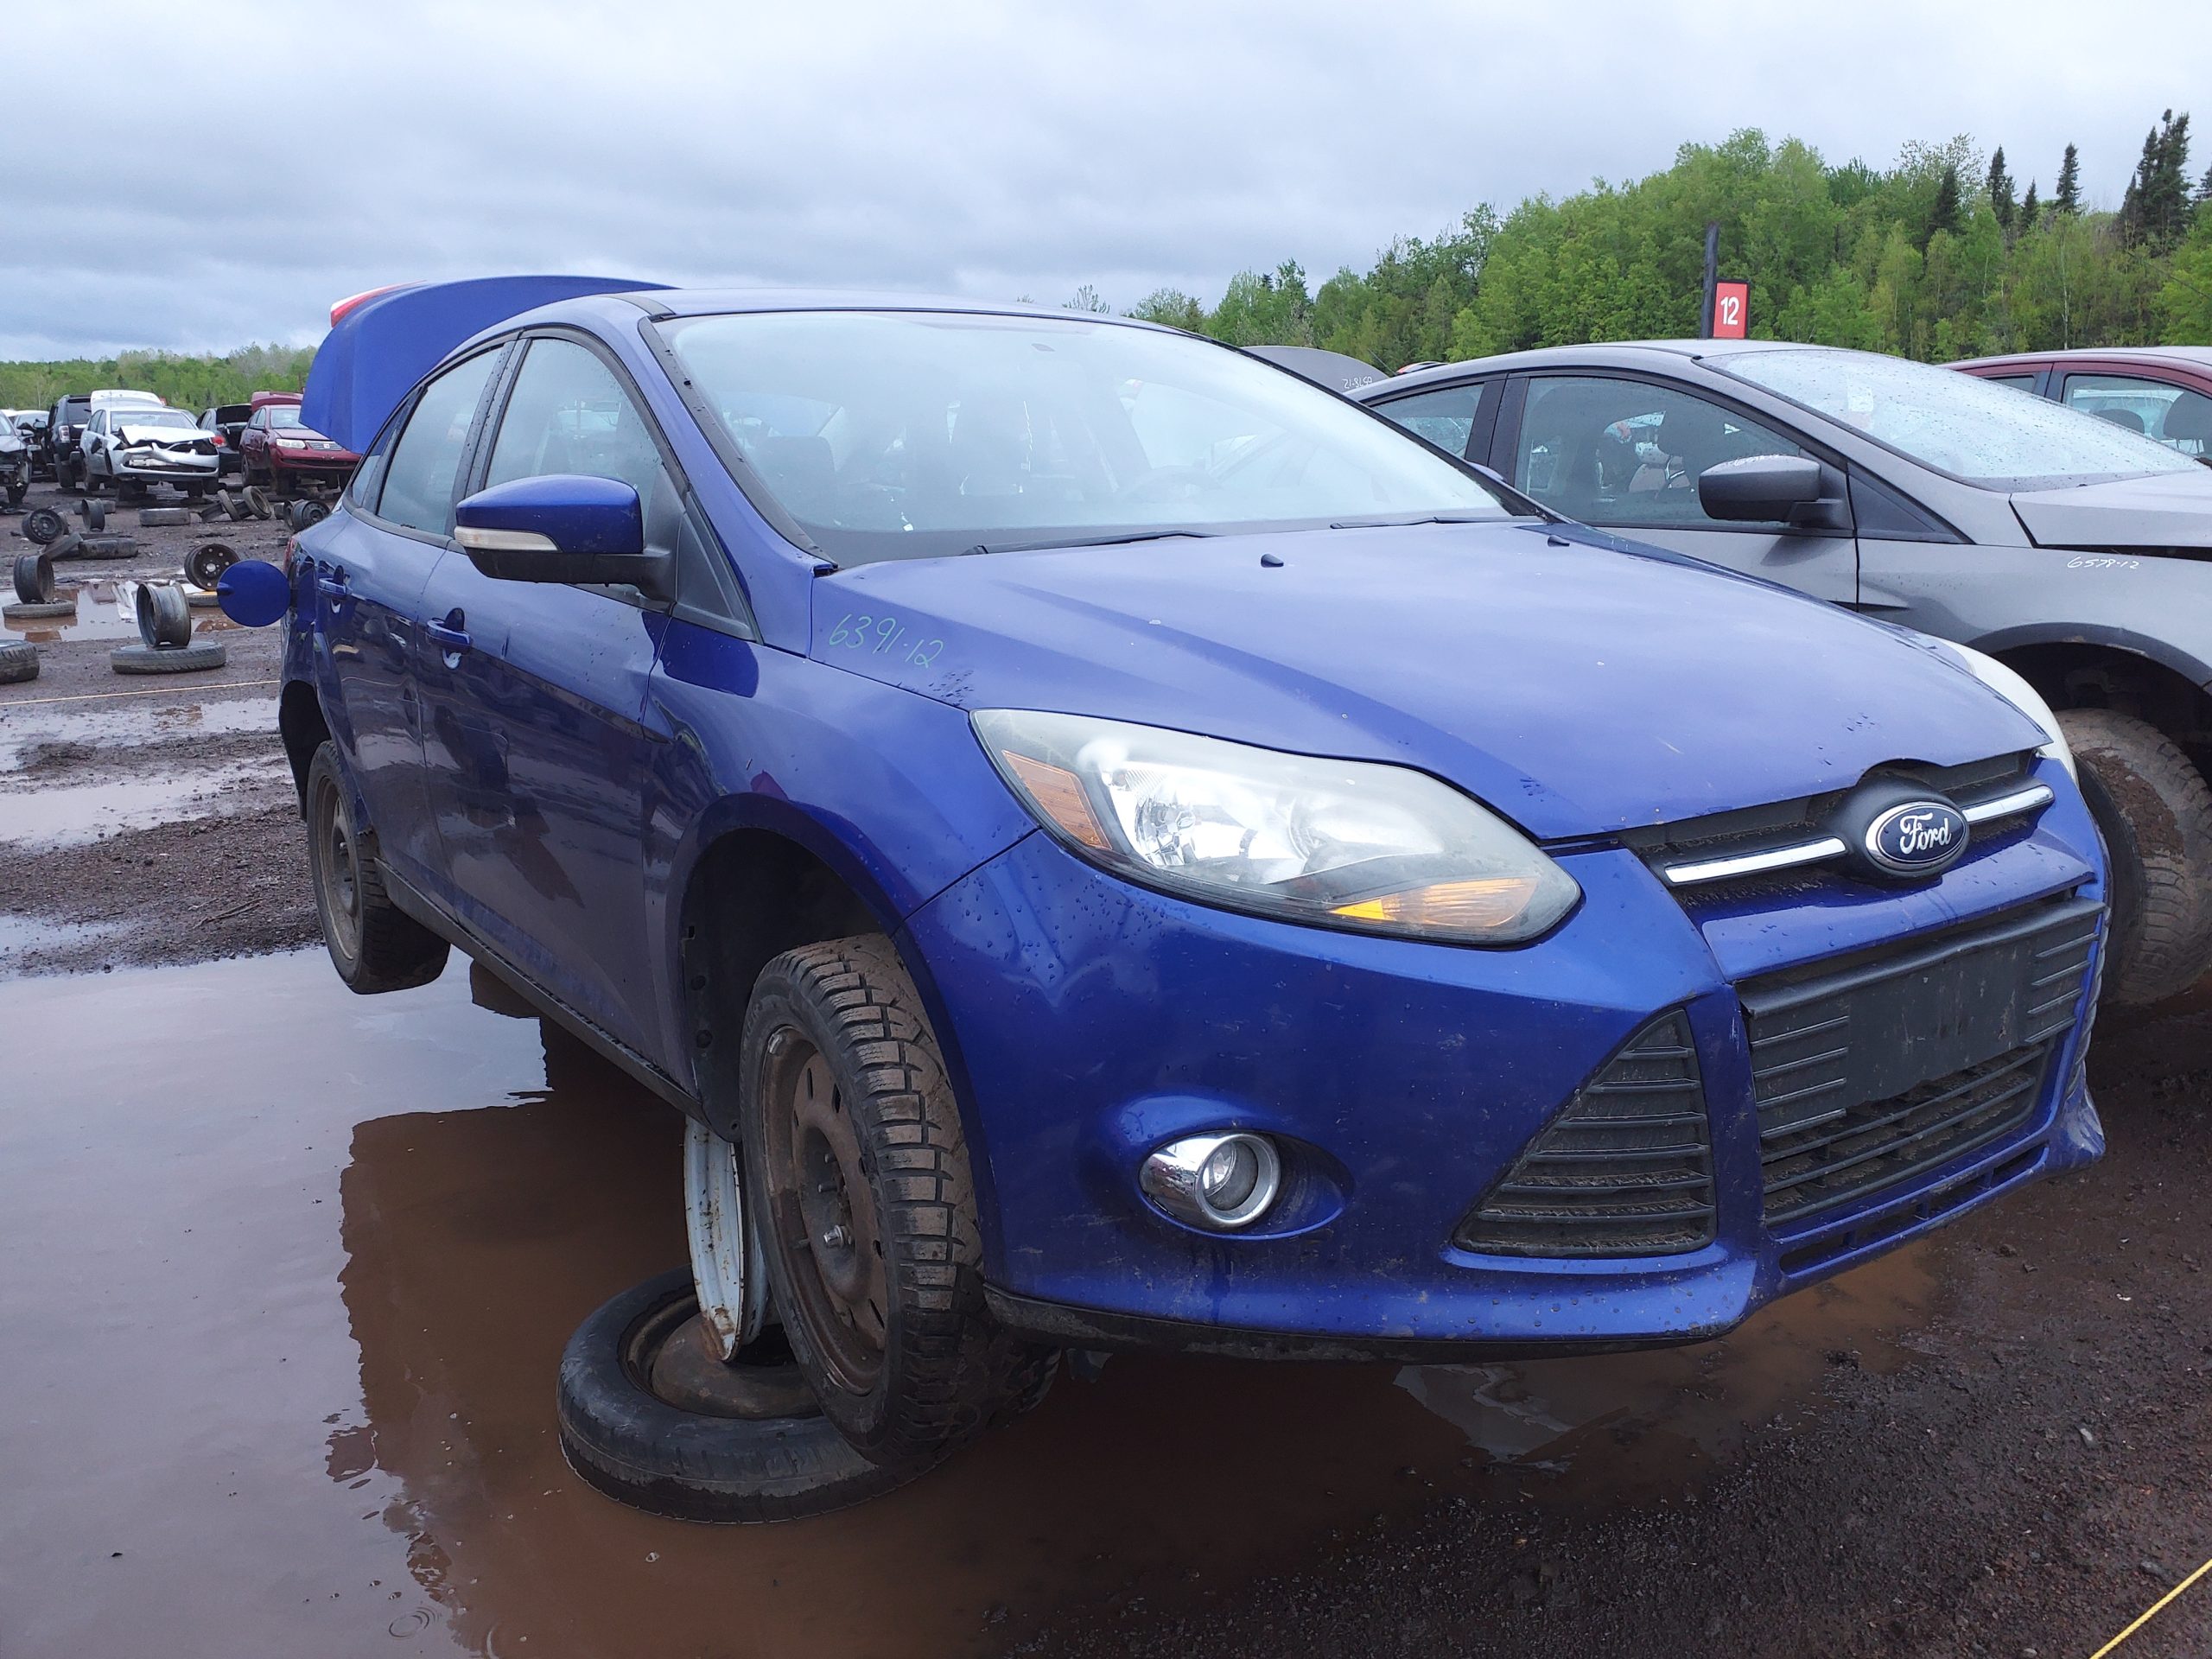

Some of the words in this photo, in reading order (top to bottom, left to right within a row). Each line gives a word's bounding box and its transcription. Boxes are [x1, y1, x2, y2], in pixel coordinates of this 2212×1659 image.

[1720, 296, 1740, 325] 12
[829, 613, 944, 669] 6391-12
[1899, 812, 1952, 855] Ford
